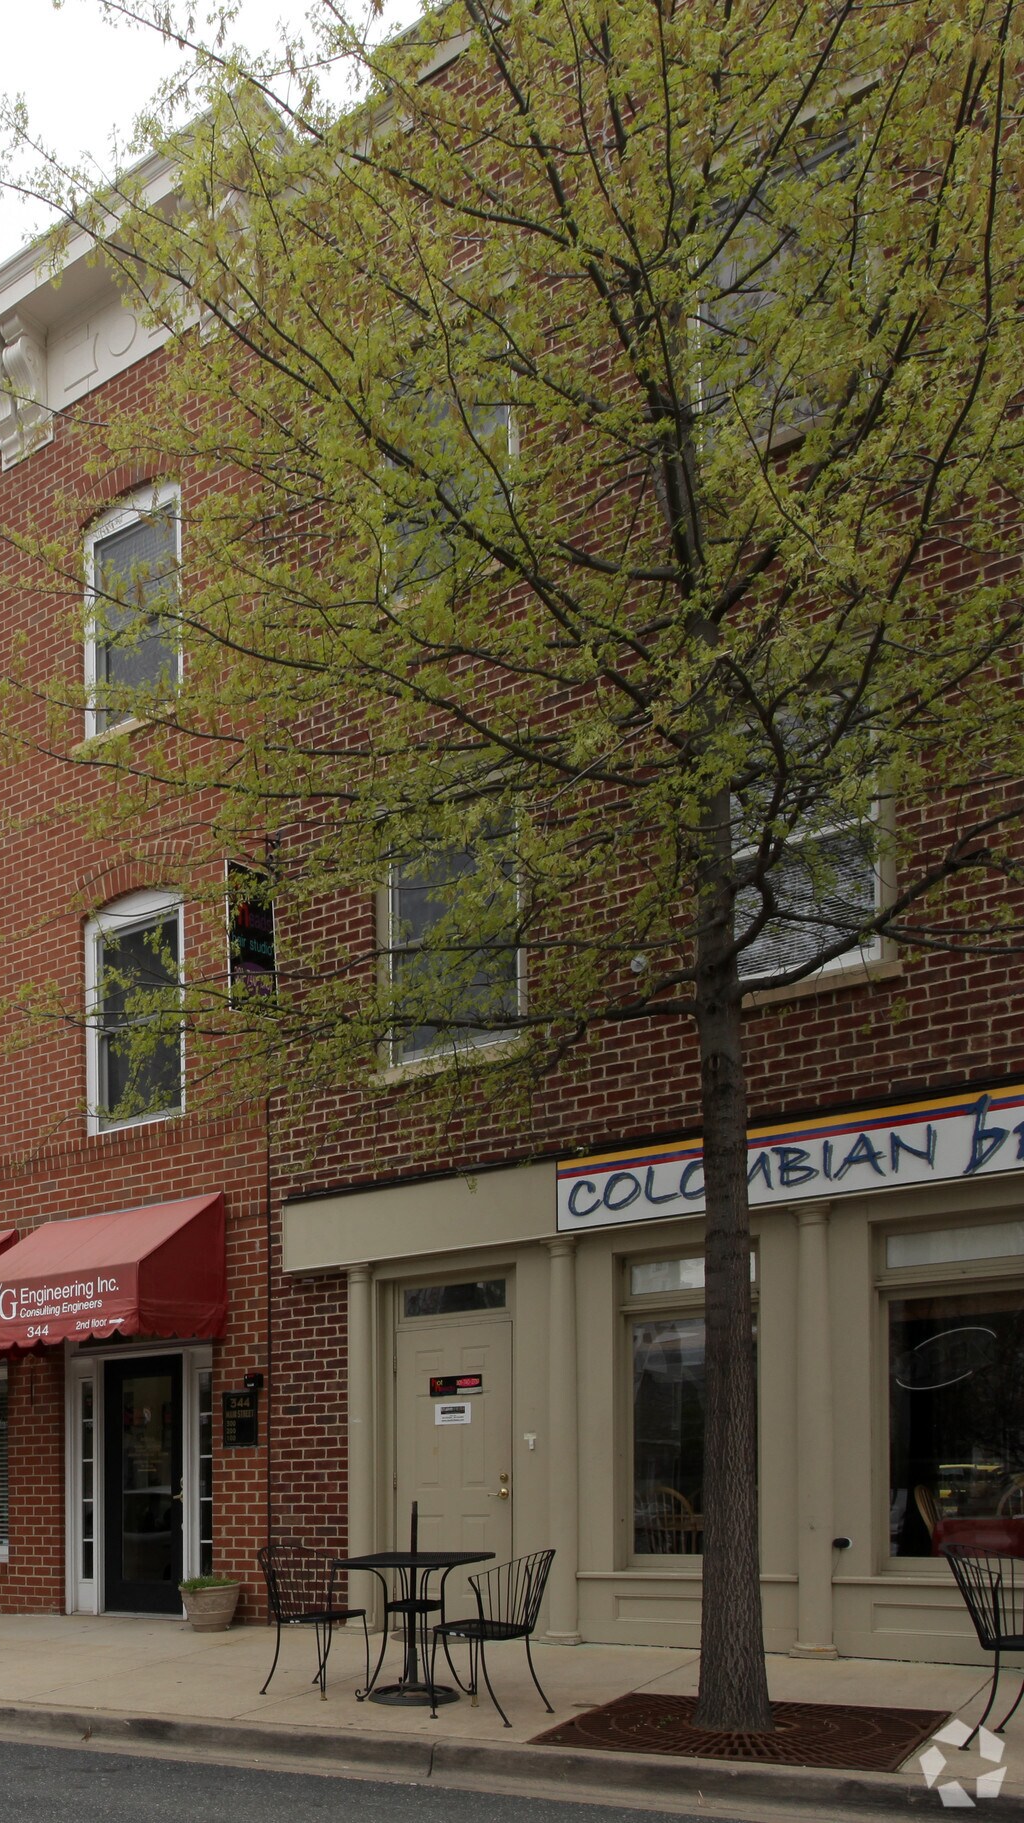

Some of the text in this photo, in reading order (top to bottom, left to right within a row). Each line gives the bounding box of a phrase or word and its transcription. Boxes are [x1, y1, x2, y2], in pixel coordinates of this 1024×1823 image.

[249, 938, 273, 956] studio
[20, 1276, 119, 1306] Engineering Inc.
[19, 1300, 103, 1319] Consulting Engineers
[75, 1317, 107, 1331] 2nd floor
[26, 1325, 49, 1338] 344
[230, 1398, 250, 1409] 344
[237, 1410, 254, 1418] STREET
[226, 1427, 236, 1435] 200
[226, 1435, 236, 1443] 100
